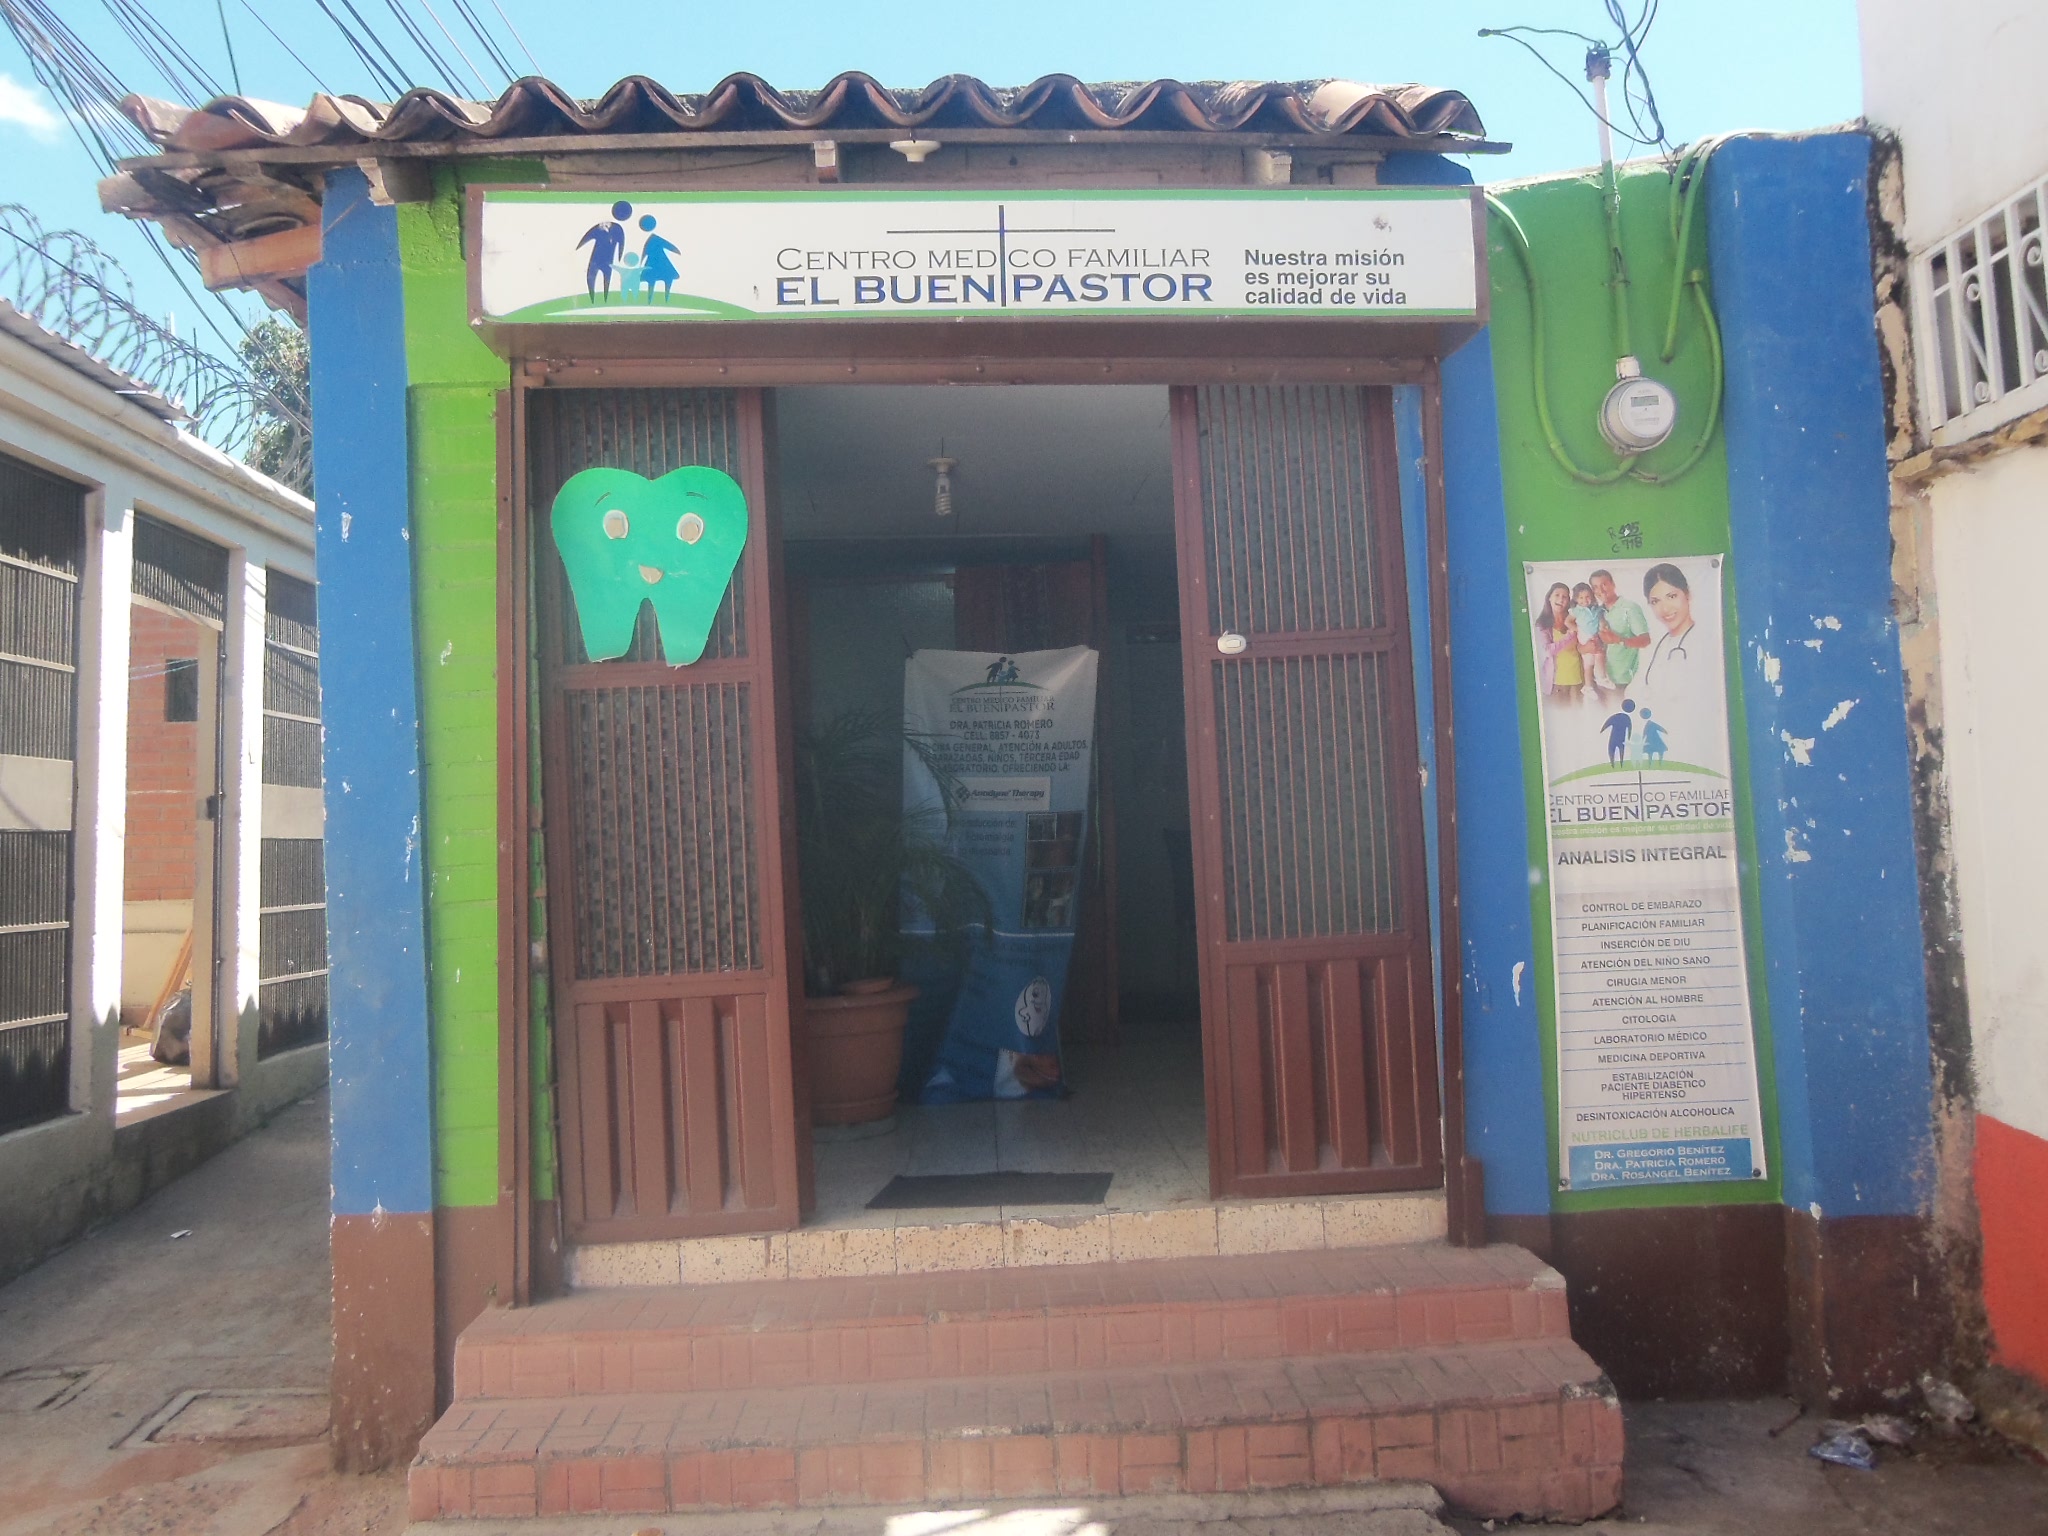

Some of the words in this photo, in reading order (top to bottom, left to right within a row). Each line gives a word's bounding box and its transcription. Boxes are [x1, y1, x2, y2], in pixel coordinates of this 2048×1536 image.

[776, 247, 916, 271] CENTRO
[1067, 248, 1211, 268] FAMILIAR
[1244, 249, 1328, 266] Nuestra
[1335, 248, 1405, 266] misión
[1244, 271, 1270, 285] es
[1277, 269, 1359, 289] mejorar
[1365, 271, 1391, 285] su
[776, 275, 840, 306] EL
[853, 274, 996, 305] BUEN
[1012, 273, 1214, 303] PASTOR
[1245, 288, 1323, 305] calidad
[1330, 288, 1356, 304] de
[1363, 288, 1407, 304] vida
[973, 720, 1011, 730] PATRICIA
[1014, 719, 1054, 729] ROMERO
[1018, 730, 1040, 740] 4073
[1019, 752, 1057, 762] TERCERA
[1058, 750, 1080, 761] EDAD
[1576, 806, 1640, 822] BUEN
[1558, 849, 1636, 865] ANALISIS
[1642, 846, 1727, 861] INTEGRAL
[1582, 902, 1629, 913] CONTROL
[1632, 902, 1644, 911] DE
[1647, 900, 1702, 910] EMBARAZO
[1581, 918, 1656, 931] PLANIFICACIÓN
[1659, 918, 1705, 928] FAMILIAR
[1601, 937, 1655, 949] INSERCIÓN
[1658, 938, 1670, 947] DE
[1673, 937, 1690, 946] DIU
[1581, 957, 1631, 969] ATENCIÓN
[1633, 957, 1652, 967] DEL
[1655, 955, 1679, 966] NIÑO
[1682, 955, 1711, 965] SANO
[1606, 977, 1648, 987] CIRUGIA
[1651, 975, 1687, 985] MENOR
[1592, 994, 1643, 1006] ATENCIÓN
[1645, 995, 1658, 1004] AL
[1660, 994, 1704, 1003] HOMBRE
[1622, 1014, 1676, 1024] CITOLOGIA
[1594, 1034, 1665, 1045] LABORATORIO
[1668, 1030, 1707, 1041] MÉDICO
[1598, 1053, 1647, 1063] MEDICINA
[1650, 1051, 1706, 1061] DEPORTIVA
[1612, 1068, 1694, 1082] ESTABILIZACIÓN
[1601, 1082, 1650, 1092] PACIENTE
[1652, 1079, 1706, 1089] DIABETICO
[1622, 1090, 1686, 1100] HIPERTENSO
[1576, 1108, 1668, 1122] DESINTOXICACIÓN
[1670, 1107, 1735, 1118] ALCOHOLICA
[1571, 1128, 1648, 1143] NUTRICLUB
[1652, 1127, 1669, 1139] DE
[1674, 1124, 1748, 1138] HERBALIFE
[1594, 1150, 1614, 1160] DR.
[1617, 1148, 1675, 1158] GREGORIO
[1677, 1145, 1725, 1155] BENÍTEZ
[1595, 1160, 1622, 1171] DRA.
[1625, 1159, 1676, 1169] PATRICIA
[1678, 1156, 1726, 1167] ROMERO
[1591, 1172, 1619, 1182] DRA.
[1683, 1166, 1732, 1177] BENÍTEZ
